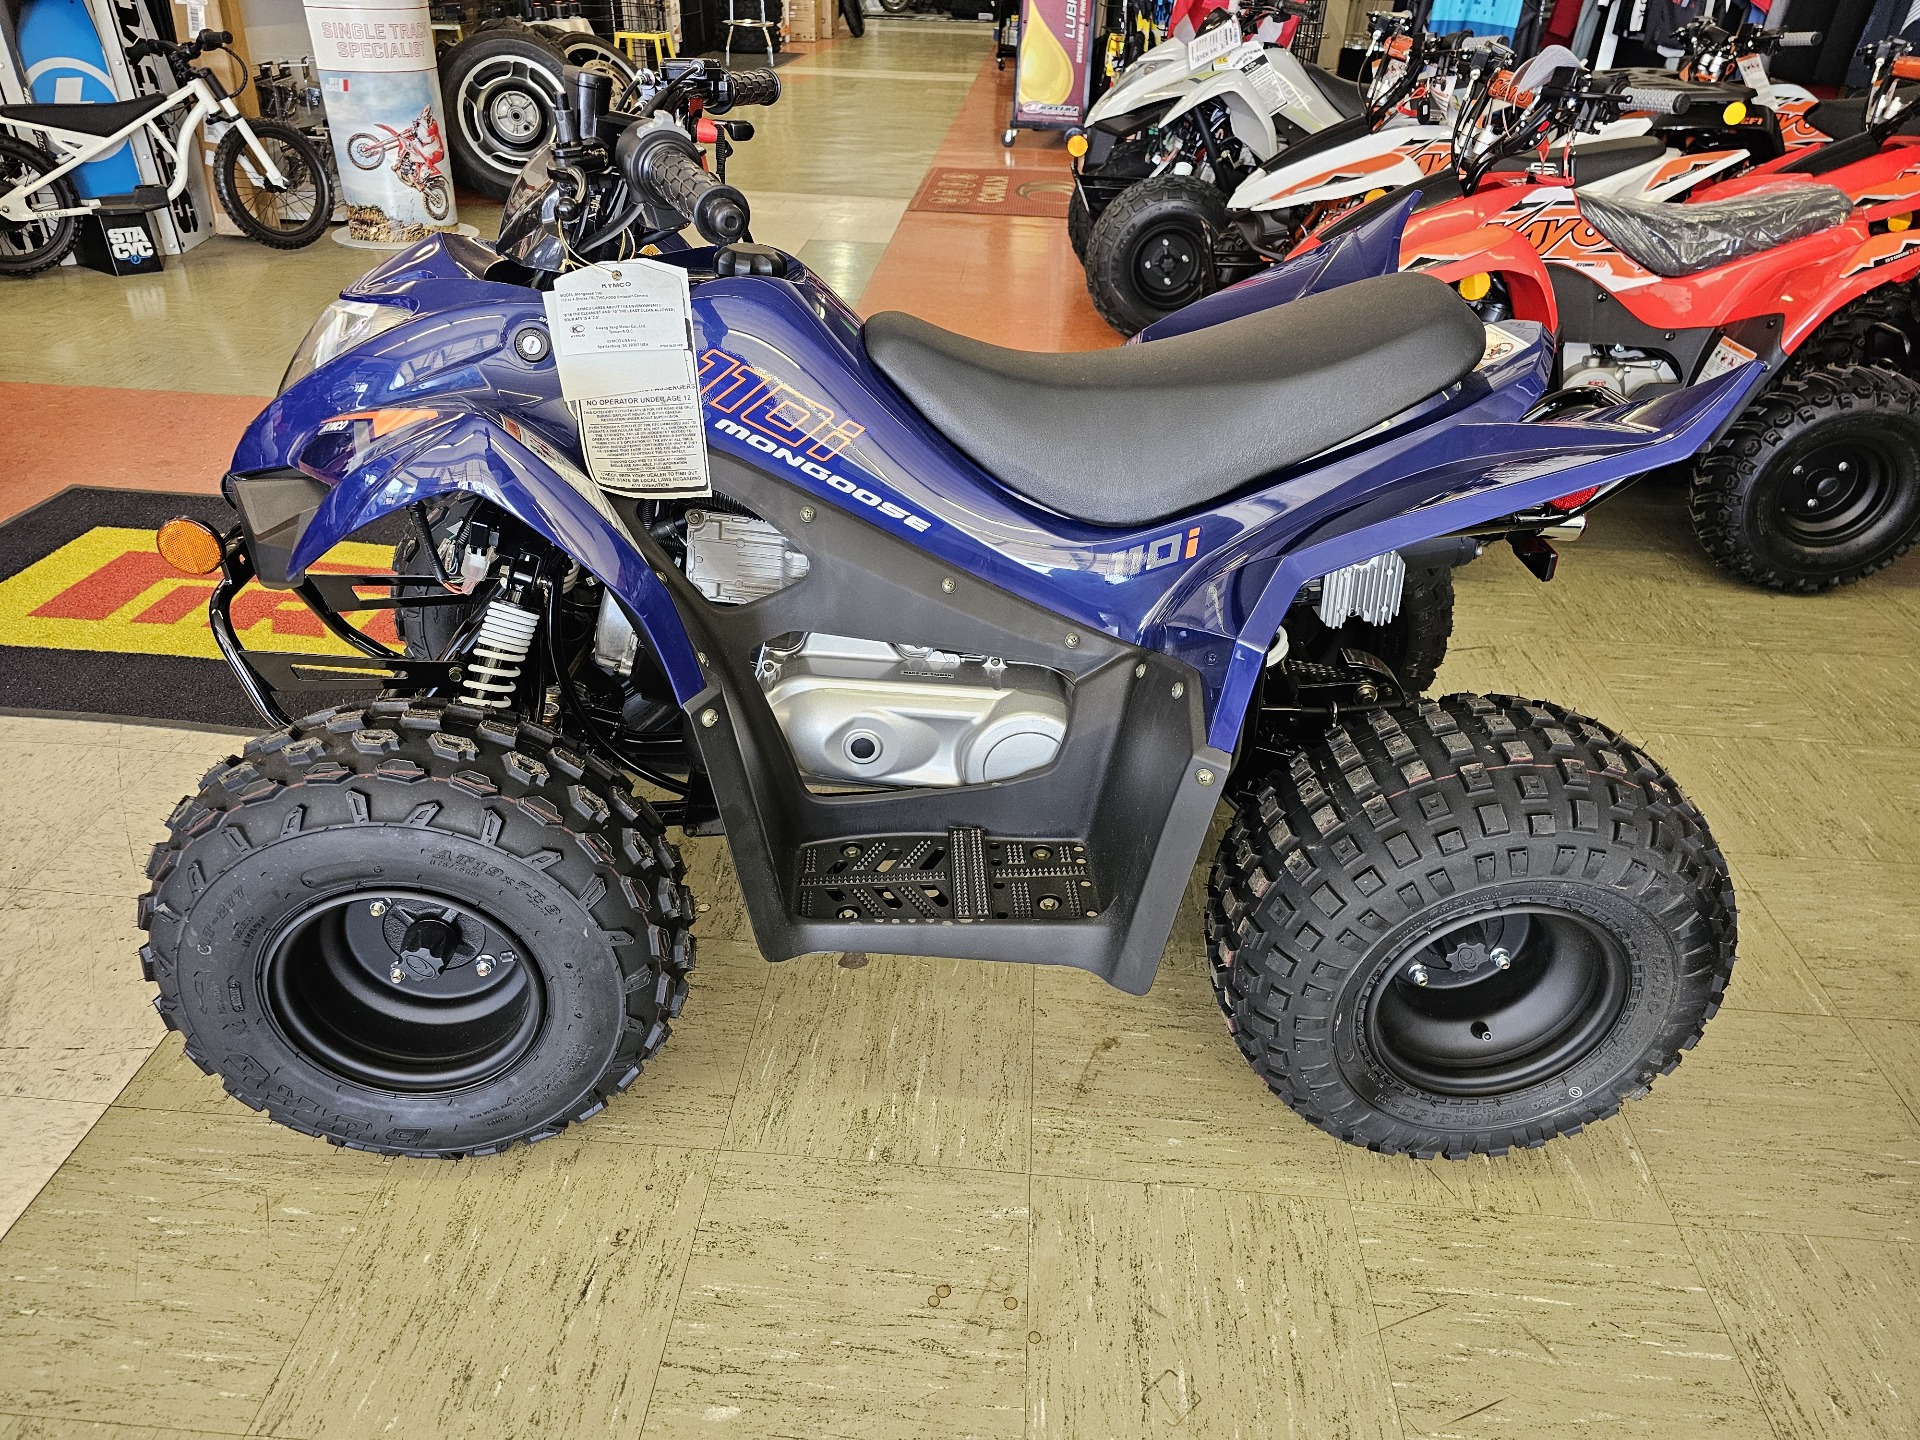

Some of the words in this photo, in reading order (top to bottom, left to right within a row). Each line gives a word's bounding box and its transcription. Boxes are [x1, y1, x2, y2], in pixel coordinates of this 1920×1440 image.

[322, 22, 387, 39] SINGLE
[389, 22, 429, 39] TRACK
[337, 41, 426, 58] SPECIALIST
[107, 226, 149, 244] STA
[112, 241, 154, 259] CYC
[601, 281, 632, 289] KYMCO
[599, 397, 639, 406] OPERATOR
[698, 347, 866, 463] 110i
[318, 419, 350, 434] KYMCO
[715, 418, 934, 534] MONGOOSE
[1106, 526, 1201, 584] 110i
